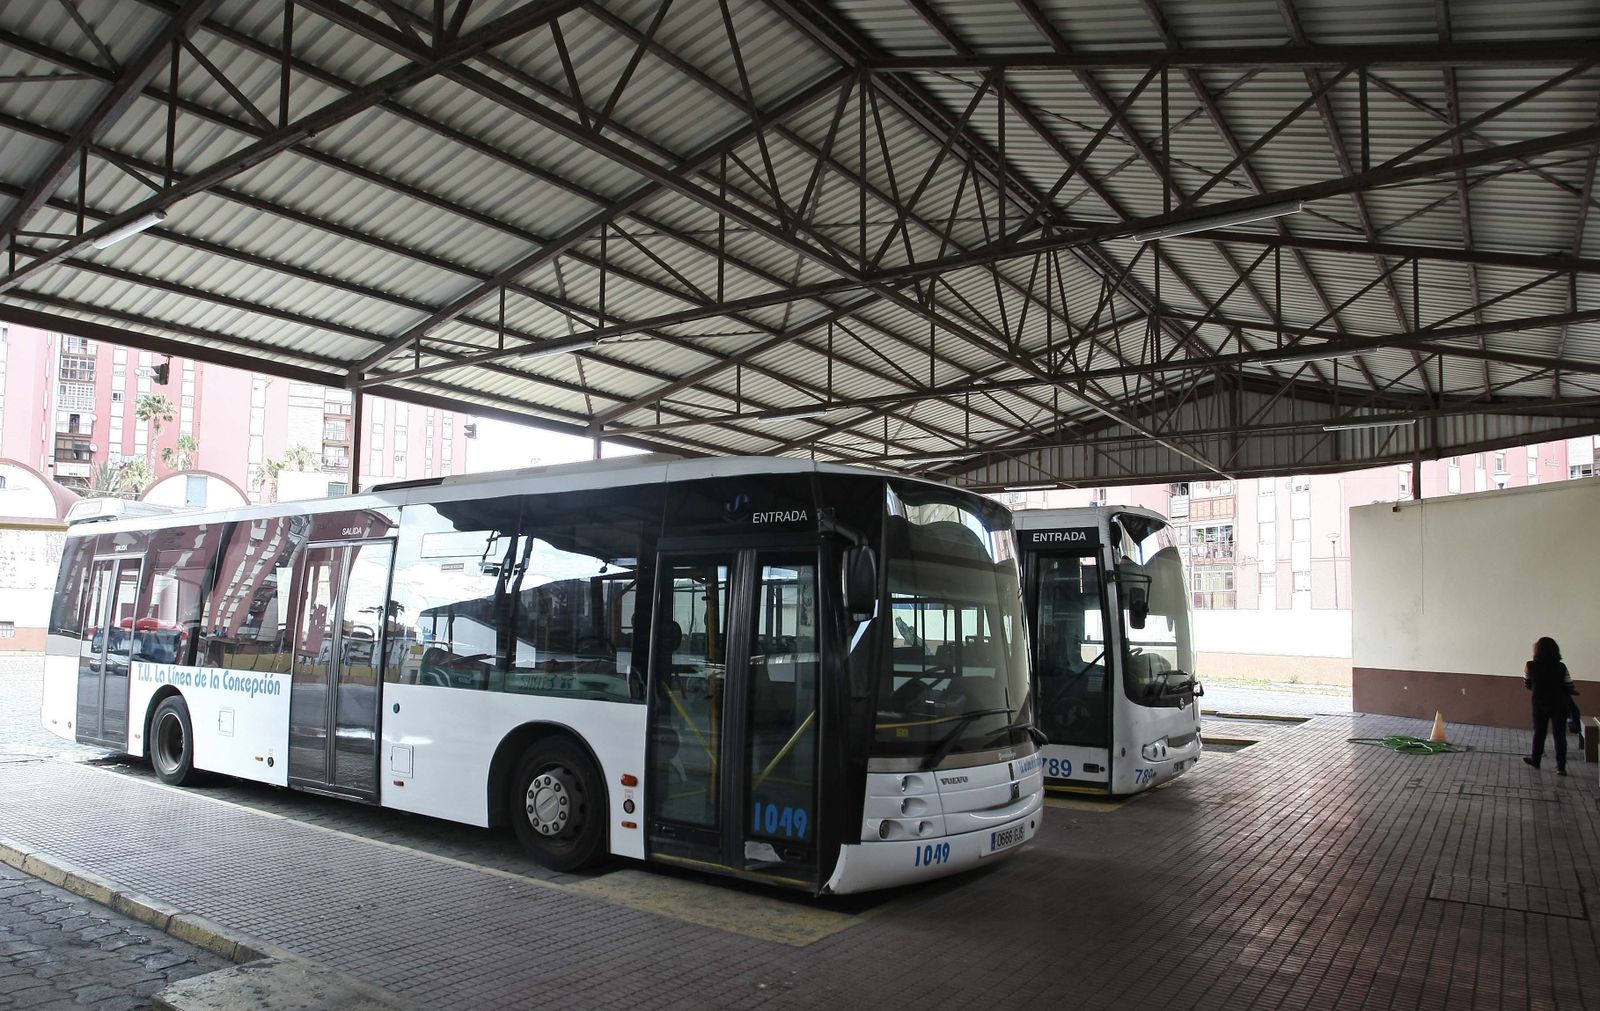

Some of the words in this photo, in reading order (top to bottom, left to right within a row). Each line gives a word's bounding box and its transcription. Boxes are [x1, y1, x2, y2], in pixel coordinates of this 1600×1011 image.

[752, 509, 808, 524] ENTRADA
[341, 526, 362, 536] SALIDA
[1032, 531, 1087, 542] ENTRADA
[137, 663, 152, 682] T.U.
[154, 668, 165, 683] La
[167, 667, 192, 686] Línea
[194, 668, 207, 688] de
[209, 669, 219, 689] la
[223, 670, 281, 699] Concepción
[940, 776, 968, 785] VOLVO
[753, 802, 808, 840] 1049
[914, 842, 951, 867] 1049
